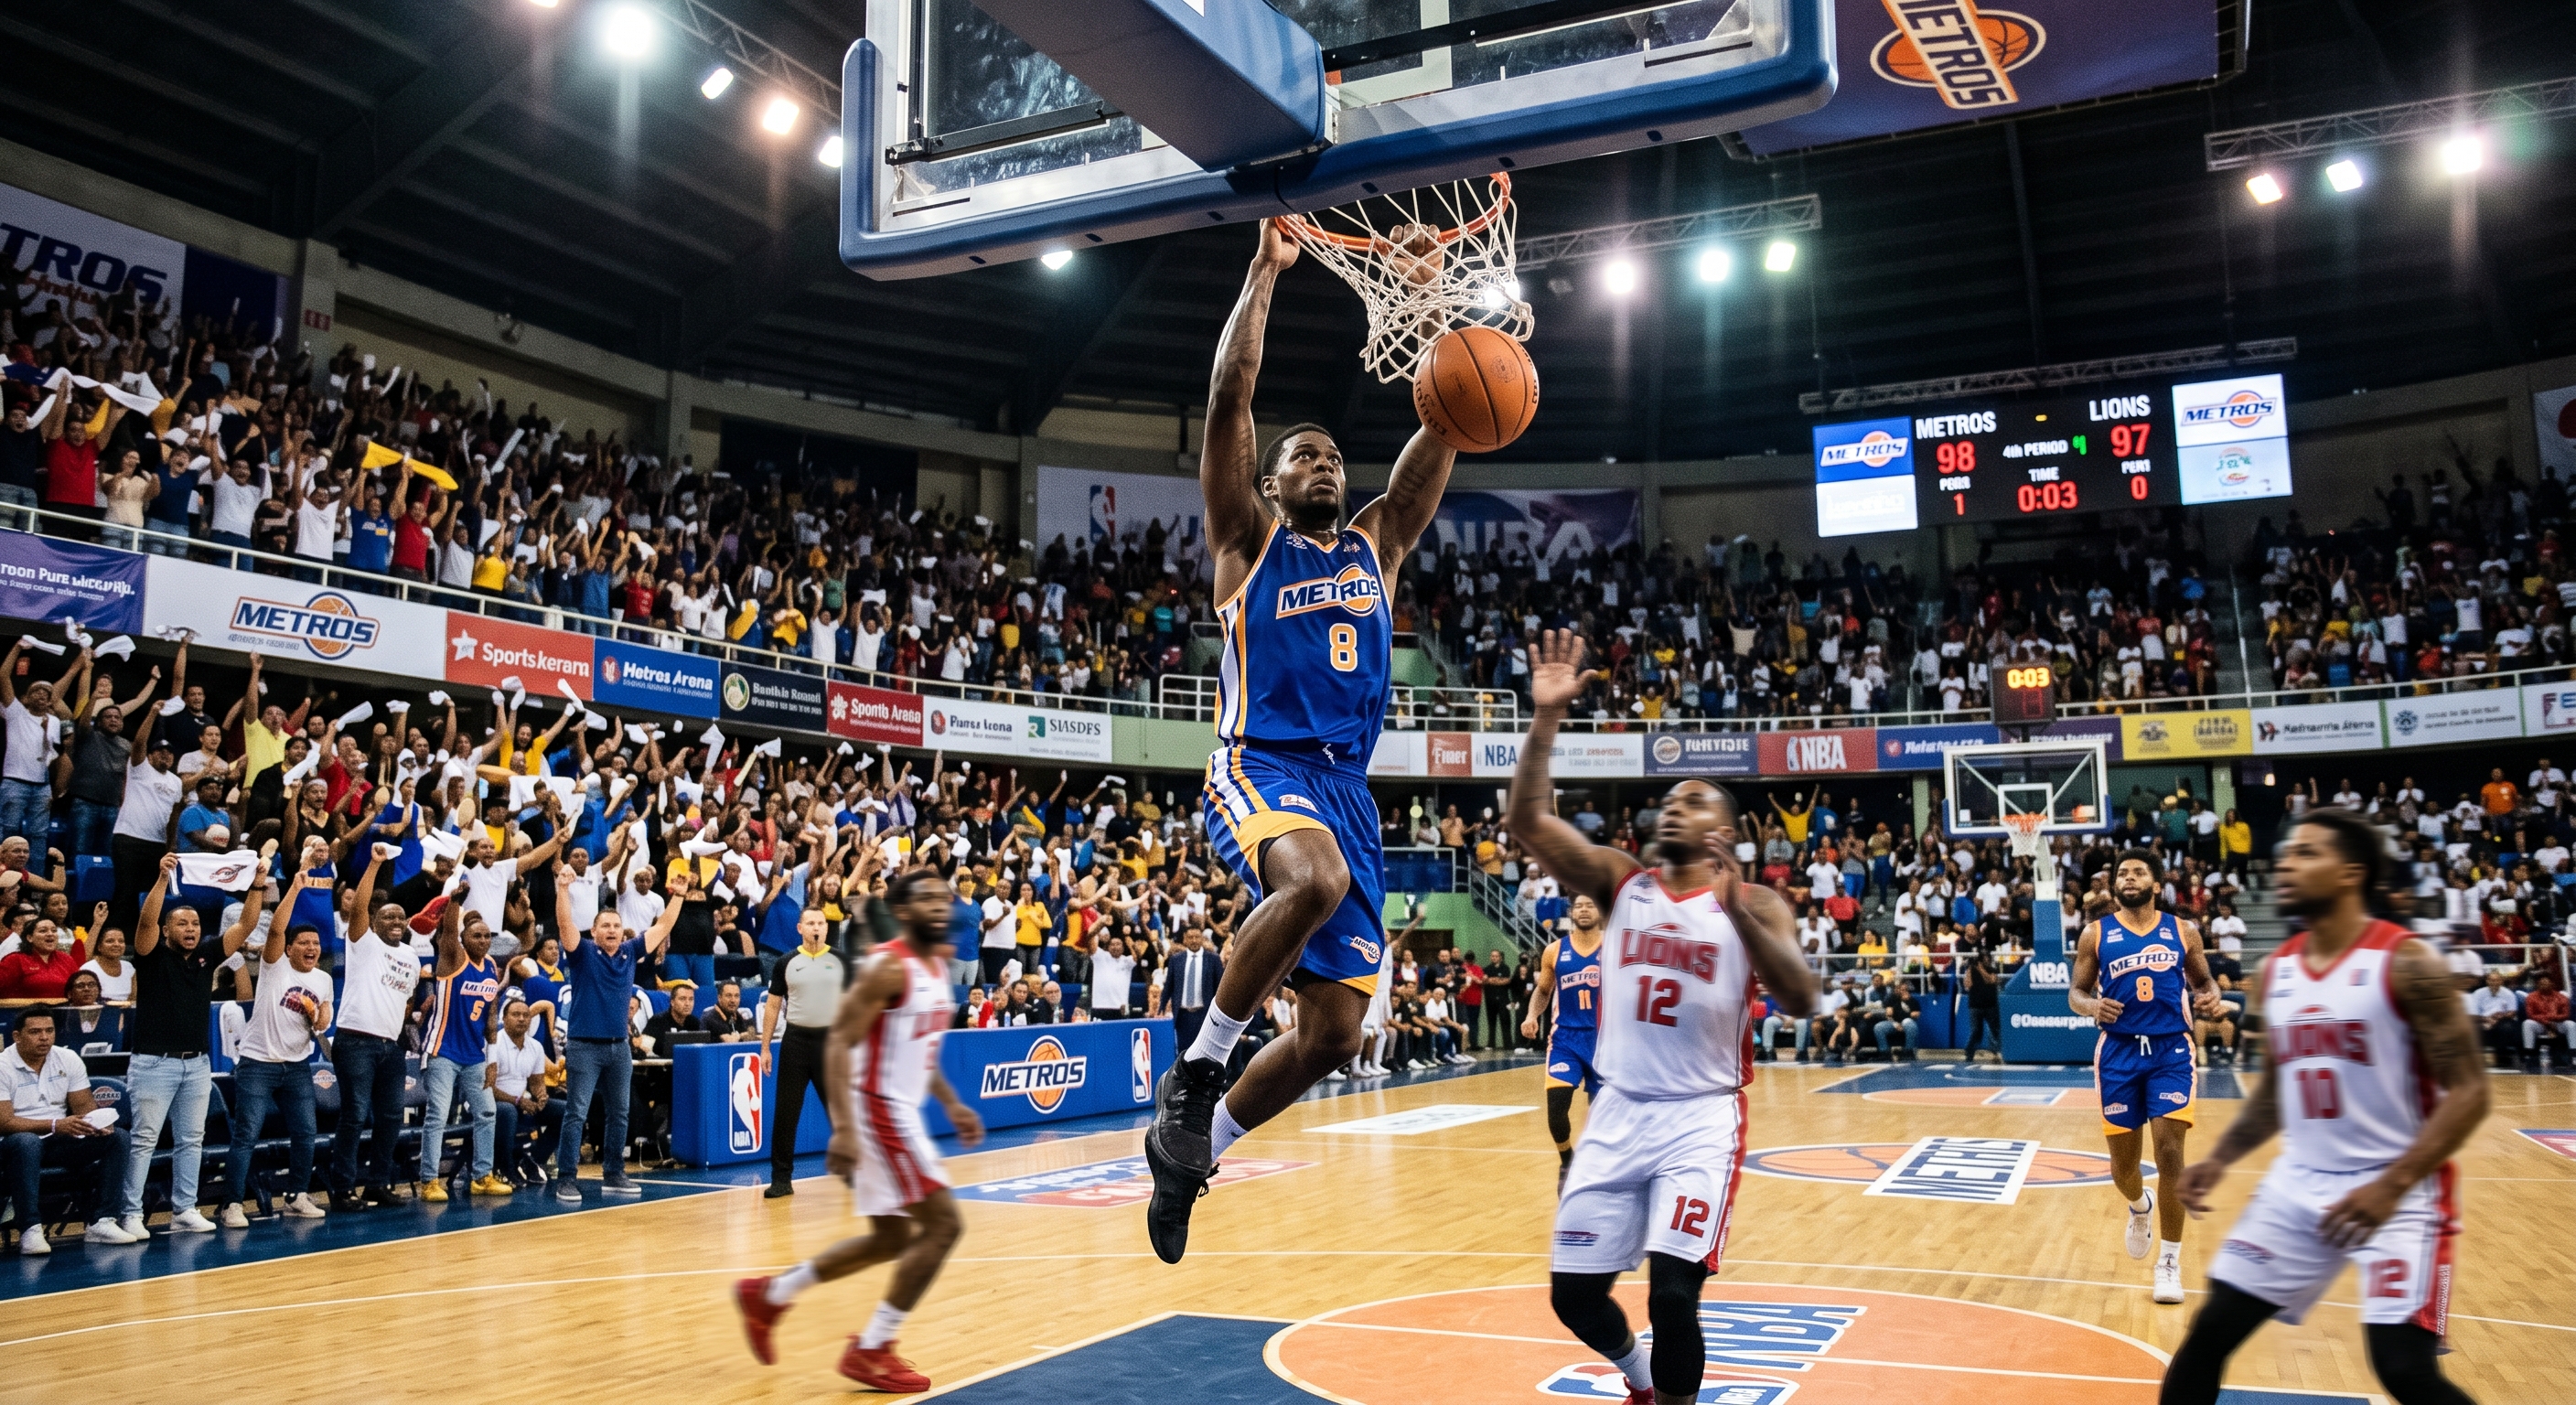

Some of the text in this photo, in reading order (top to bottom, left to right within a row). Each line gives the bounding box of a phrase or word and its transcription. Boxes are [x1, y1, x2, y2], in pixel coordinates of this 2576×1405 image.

[1897, 0, 2008, 105] ETROS
[2089, 394, 2151, 421] LIONS
[2185, 402, 2272, 421] METROS
[1916, 411, 1997, 439] METROS
[2023, 439, 2068, 456] PERIOD
[2110, 423, 2151, 457] 97
[1937, 441, 1976, 474] 98
[2028, 467, 2060, 482] TIME
[2131, 476, 2148, 500] 0
[1953, 493, 1965, 515] 1
[2018, 481, 2078, 512] 0:03
[1281, 579, 1379, 611] METROS
[236, 603, 376, 643] METROS
[1329, 623, 1358, 671] 8
[2007, 667, 2050, 689] 0:03
[1485, 745, 1518, 767] NBA
[1799, 735, 1847, 771] NBA
[1619, 928, 1721, 984] LIONS
[2029, 961, 2070, 983] NBA
[1578, 989, 1593, 1010] 11
[1637, 975, 1682, 1027] 12
[2136, 975, 2153, 1002] 8
[469, 1000, 485, 1022] 5
[984, 1061, 1084, 1094] METROS
[1669, 1196, 1710, 1239] 12
